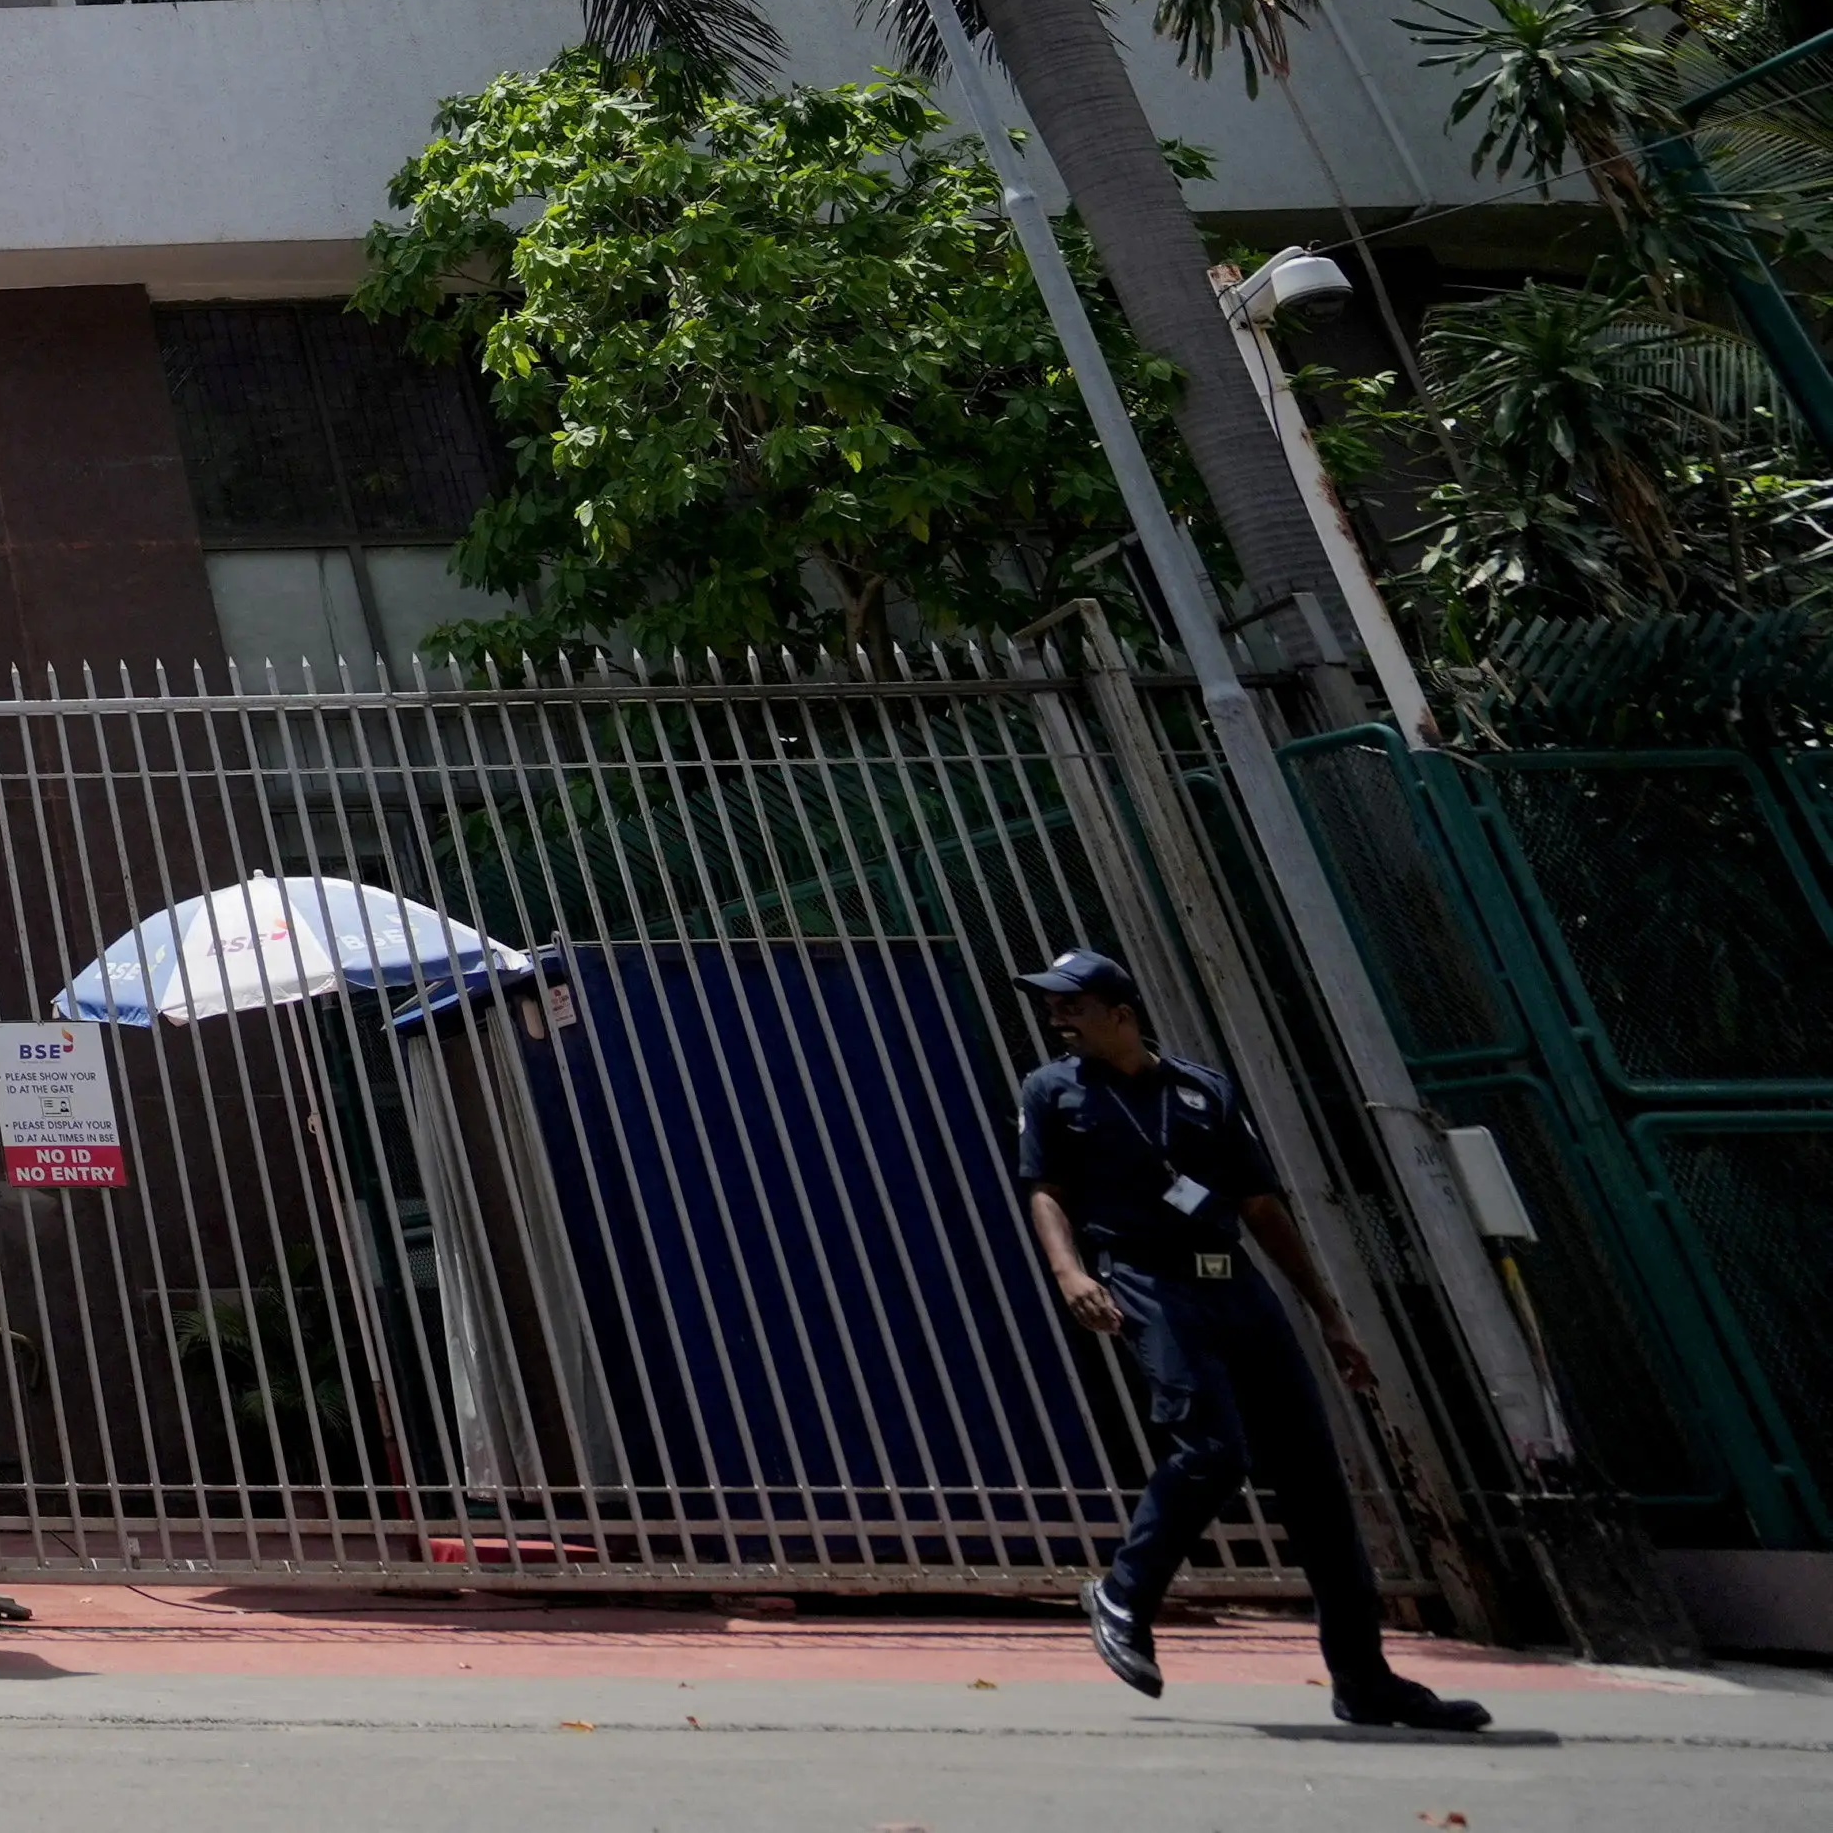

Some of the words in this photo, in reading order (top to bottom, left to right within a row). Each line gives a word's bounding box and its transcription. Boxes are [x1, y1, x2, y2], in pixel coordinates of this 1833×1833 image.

[19, 1044, 61, 1060] BSE
[5, 1072, 37, 1082] PLEASE
[39, 1071, 68, 1082] SHOW
[70, 1071, 96, 1081] YOUR
[6, 1085, 17, 1094] ID
[19, 1084, 31, 1094] AT
[32, 1084, 49, 1094] THE
[50, 1084, 74, 1094] GATE
[12, 1120, 45, 1131] PLEASE
[48, 1120, 84, 1130] DISPLAY
[86, 1120, 112, 1130] YOUR
[14, 1133, 25, 1143] ID
[27, 1133, 39, 1143] AT
[41, 1133, 57, 1143] ALL
[59, 1133, 84, 1143] TIMES
[87, 1133, 98, 1143] IN
[99, 1133, 115, 1143] BSE
[36, 1148, 65, 1164] NO
[71, 1148, 91, 1163] ID
[16, 1167, 46, 1182] NO
[51, 1166, 116, 1182] ENTRY
